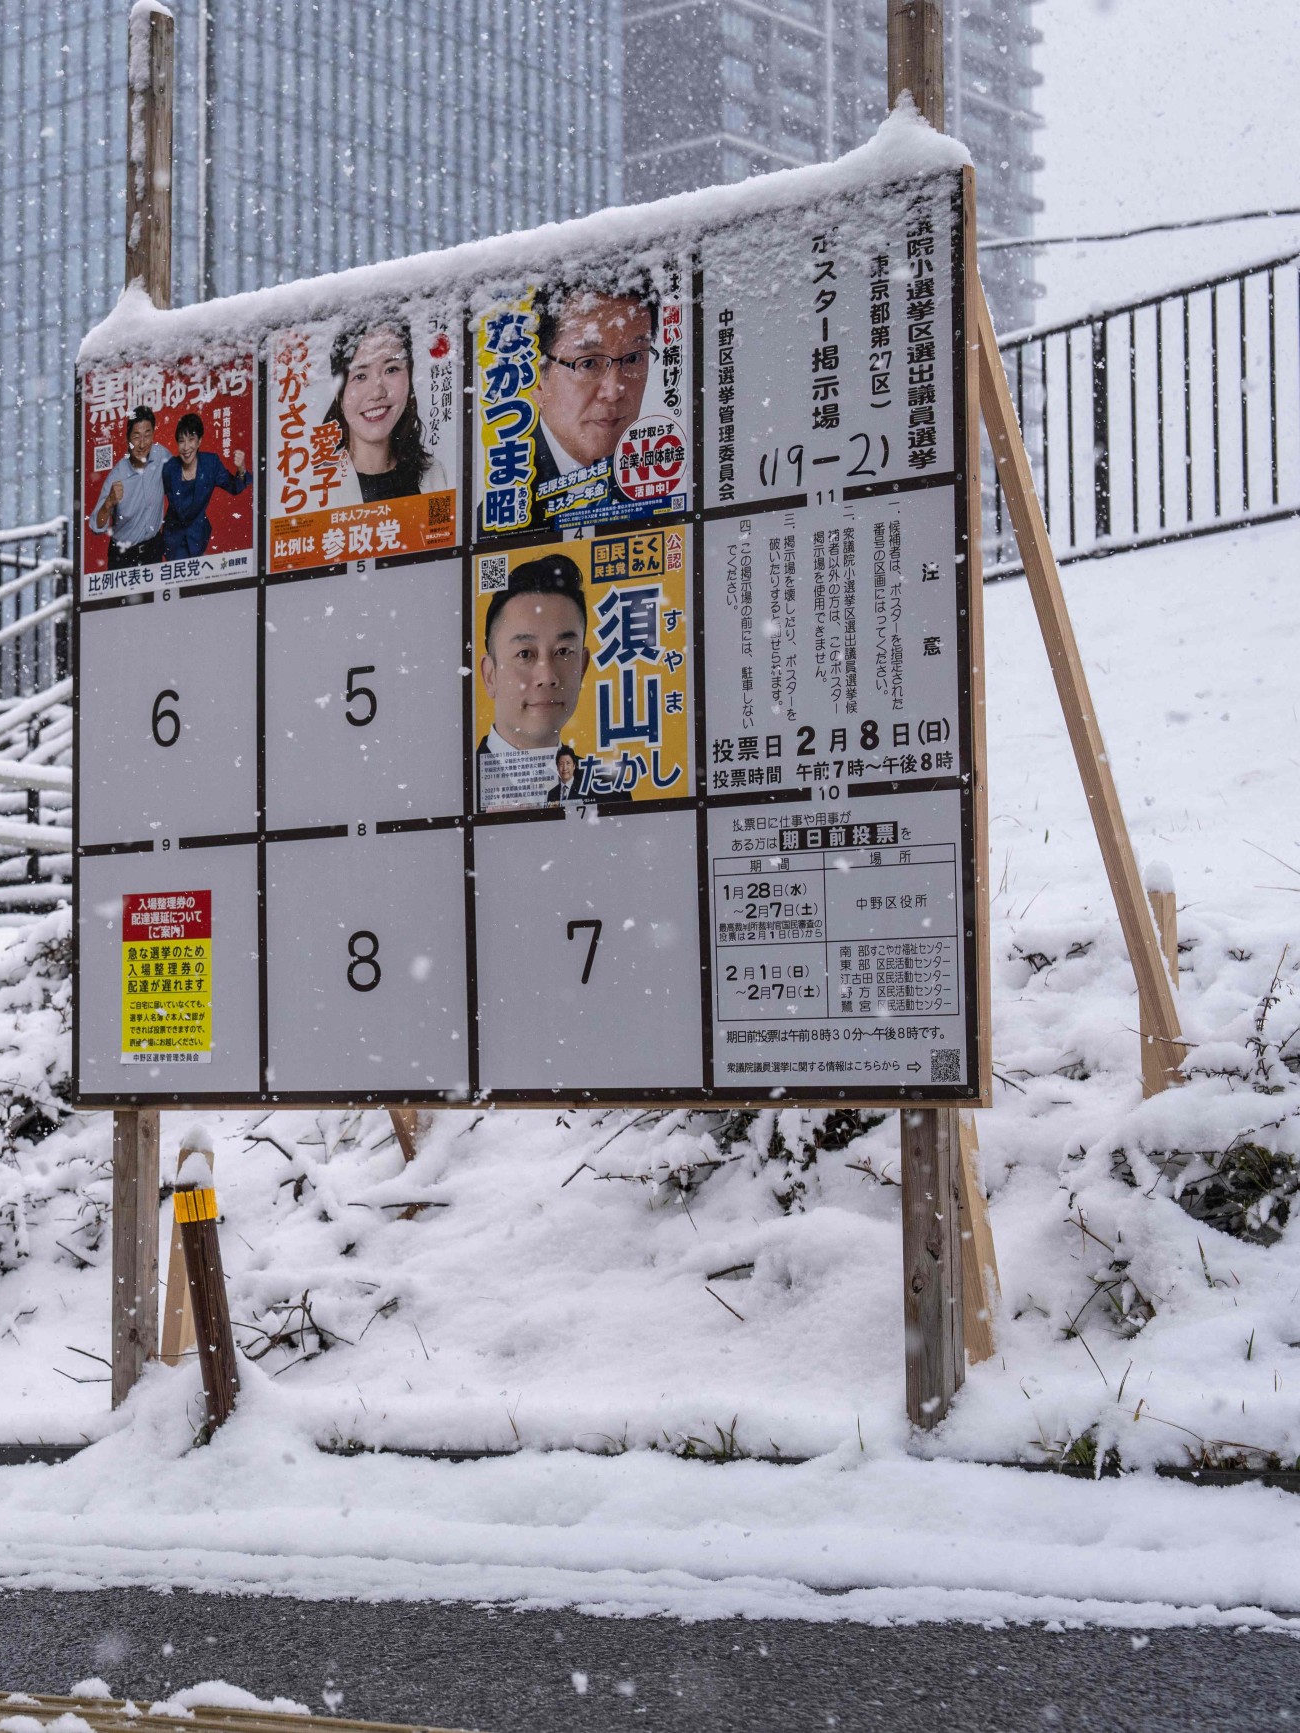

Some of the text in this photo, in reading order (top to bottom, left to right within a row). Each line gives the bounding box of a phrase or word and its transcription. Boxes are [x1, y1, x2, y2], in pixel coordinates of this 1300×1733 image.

[811, 225, 840, 430] ポスター掲示場
[869, 242, 892, 409] 東京都第27区）
[906, 196, 937, 469] 議院小選挙区選出議員選挙
[718, 308, 735, 501] 中野区選挙管理委員会
[628, 423, 675, 441] 受け取らず
[310, 420, 343, 508] 愛子
[340, 449, 349, 478] あいこ
[619, 446, 685, 470] 企業・団体献金
[621, 434, 682, 484] NO
[537, 460, 608, 497] 元厚生労働大臣
[517, 485, 528, 522] あきら
[547, 484, 608, 512] ミスター年金
[816, 489, 835, 506] 11
[330, 504, 392, 524] 日本人ファースト
[274, 537, 315, 559] 比例は
[321, 519, 401, 560] 参政党
[596, 538, 659, 563] 国民 こく
[666, 533, 683, 571] 公認
[88, 567, 154, 592] 比例代表も
[160, 559, 214, 581] 自民党へ
[228, 556, 248, 566] 自民党
[357, 560, 366, 573] 5
[594, 554, 660, 577] 民主党 みん
[726, 544, 739, 611] でください。
[163, 589, 171, 601] 6
[812, 530, 827, 683] 掲示場を使用できません。
[828, 528, 842, 714] 補者以外の方は、このポスター
[873, 522, 888, 696] 番号の区画にはってください。
[596, 588, 660, 748] 須山
[663, 610, 683, 714] すやま
[345, 665, 378, 727] 5
[151, 688, 181, 748] 6
[712, 734, 783, 764] 投票日
[579, 751, 682, 795] たかし
[712, 767, 782, 789] 投票時間
[818, 785, 840, 801] 10
[575, 806, 586, 820] 7
[732, 811, 852, 832] 投票日に仕事や用事が
[356, 823, 367, 837] 8
[160, 838, 171, 851] 9
[869, 849, 911, 866] 場所
[138, 896, 196, 912] 入場整理券の
[856, 893, 928, 910] 中野区役所
[131, 910, 203, 926] 配達遅延について
[719, 919, 823, 933] 最高裁判所裁判官国民審査の
[127, 945, 205, 960] 急な選挙のため
[346, 930, 382, 993] 8
[567, 919, 602, 985] 7
[127, 962, 205, 976] 入場整理券の
[127, 978, 204, 993] 配達が遅れます
[129, 1037, 204, 1047] 直接場にお越しください。
[133, 1051, 200, 1063] 中野区選挙管理委員会
[726, 1059, 901, 1074] 衆議院議員選挙に関する情報はこちらから
